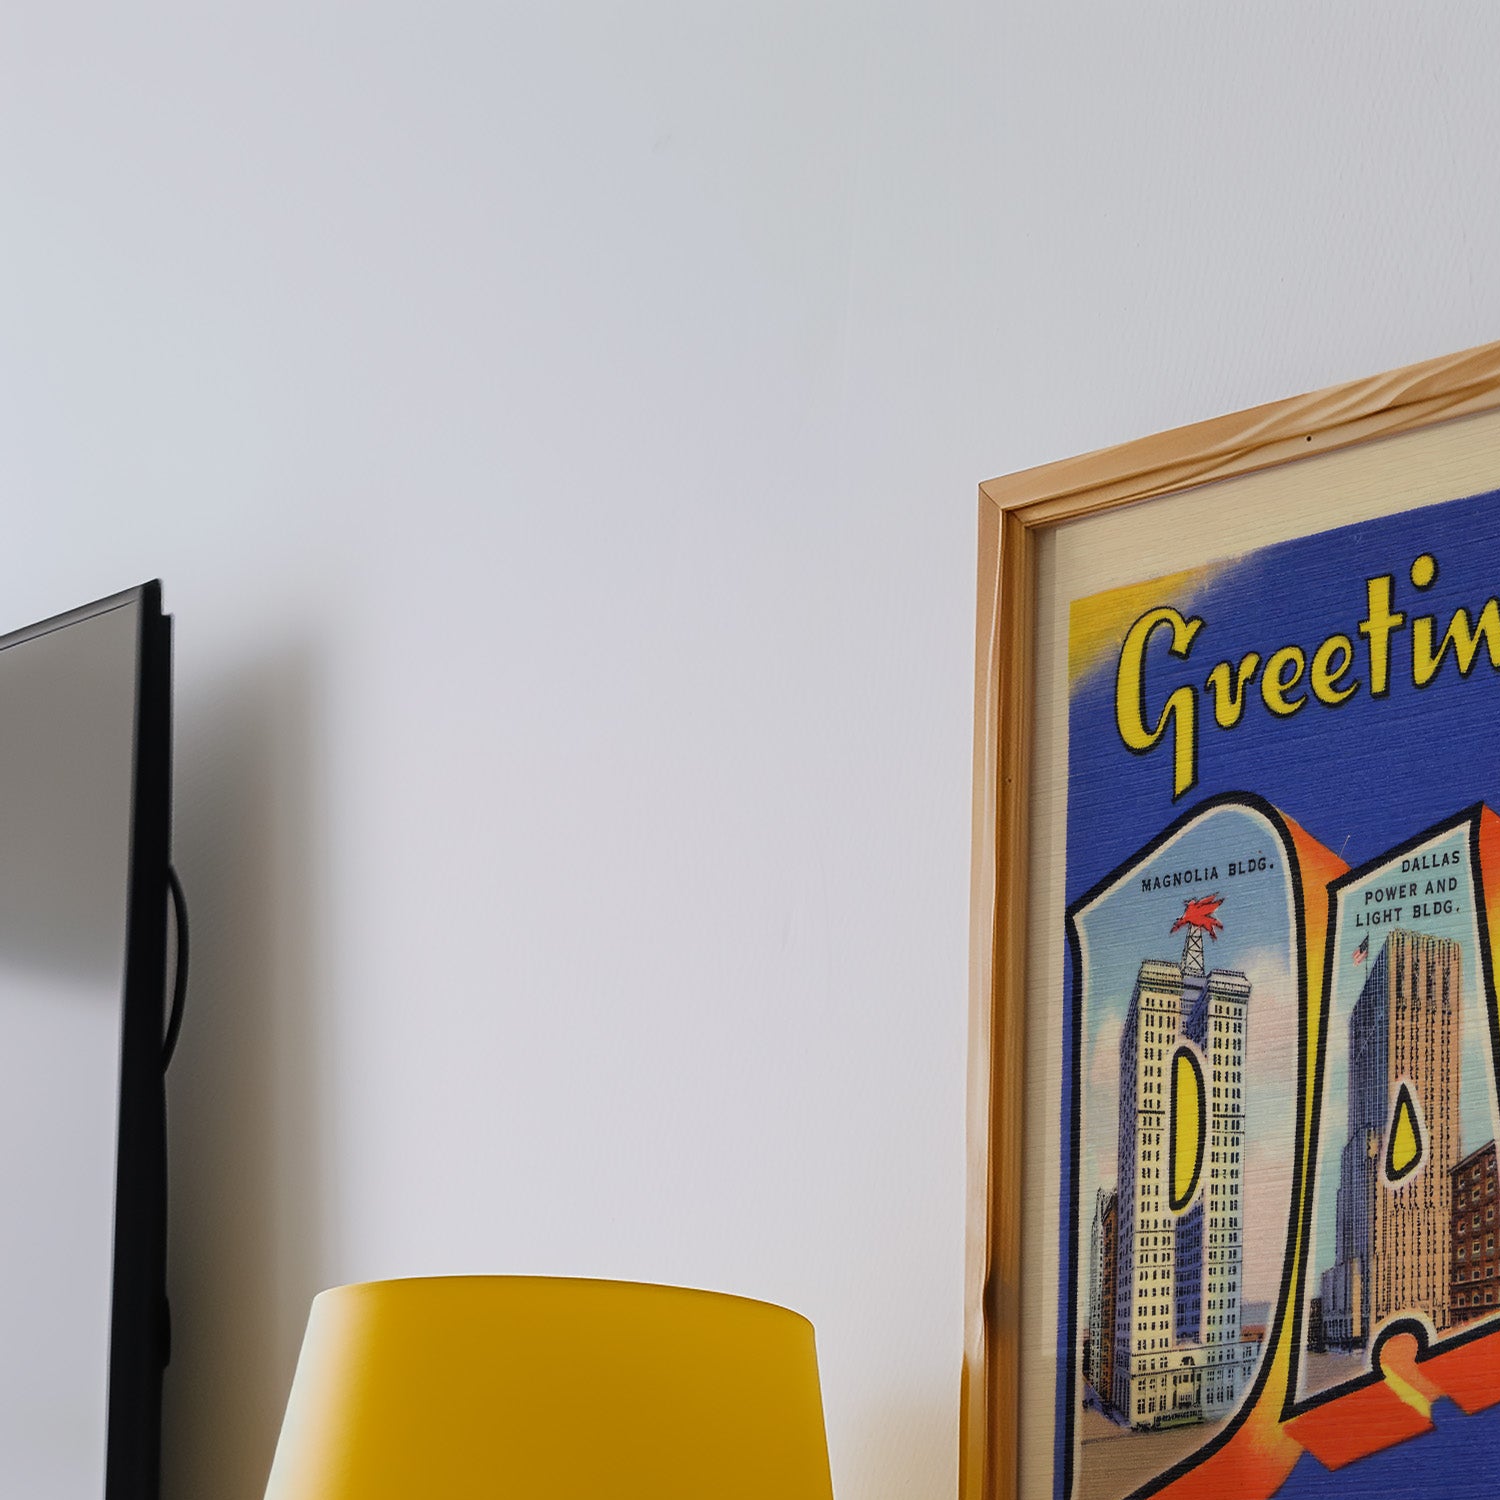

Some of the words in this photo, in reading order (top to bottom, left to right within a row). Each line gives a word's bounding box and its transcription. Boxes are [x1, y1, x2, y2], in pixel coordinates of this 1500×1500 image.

[1141, 867, 1219, 893] MAGNOLIA
[1228, 857, 1275, 877] BLDG.
[1401, 850, 1461, 873] DALLAS
[1364, 885, 1417, 906] POWER
[1425, 877, 1458, 896] AND
[1355, 907, 1404, 928] LIGHT
[1413, 899, 1460, 919] BLDG.
